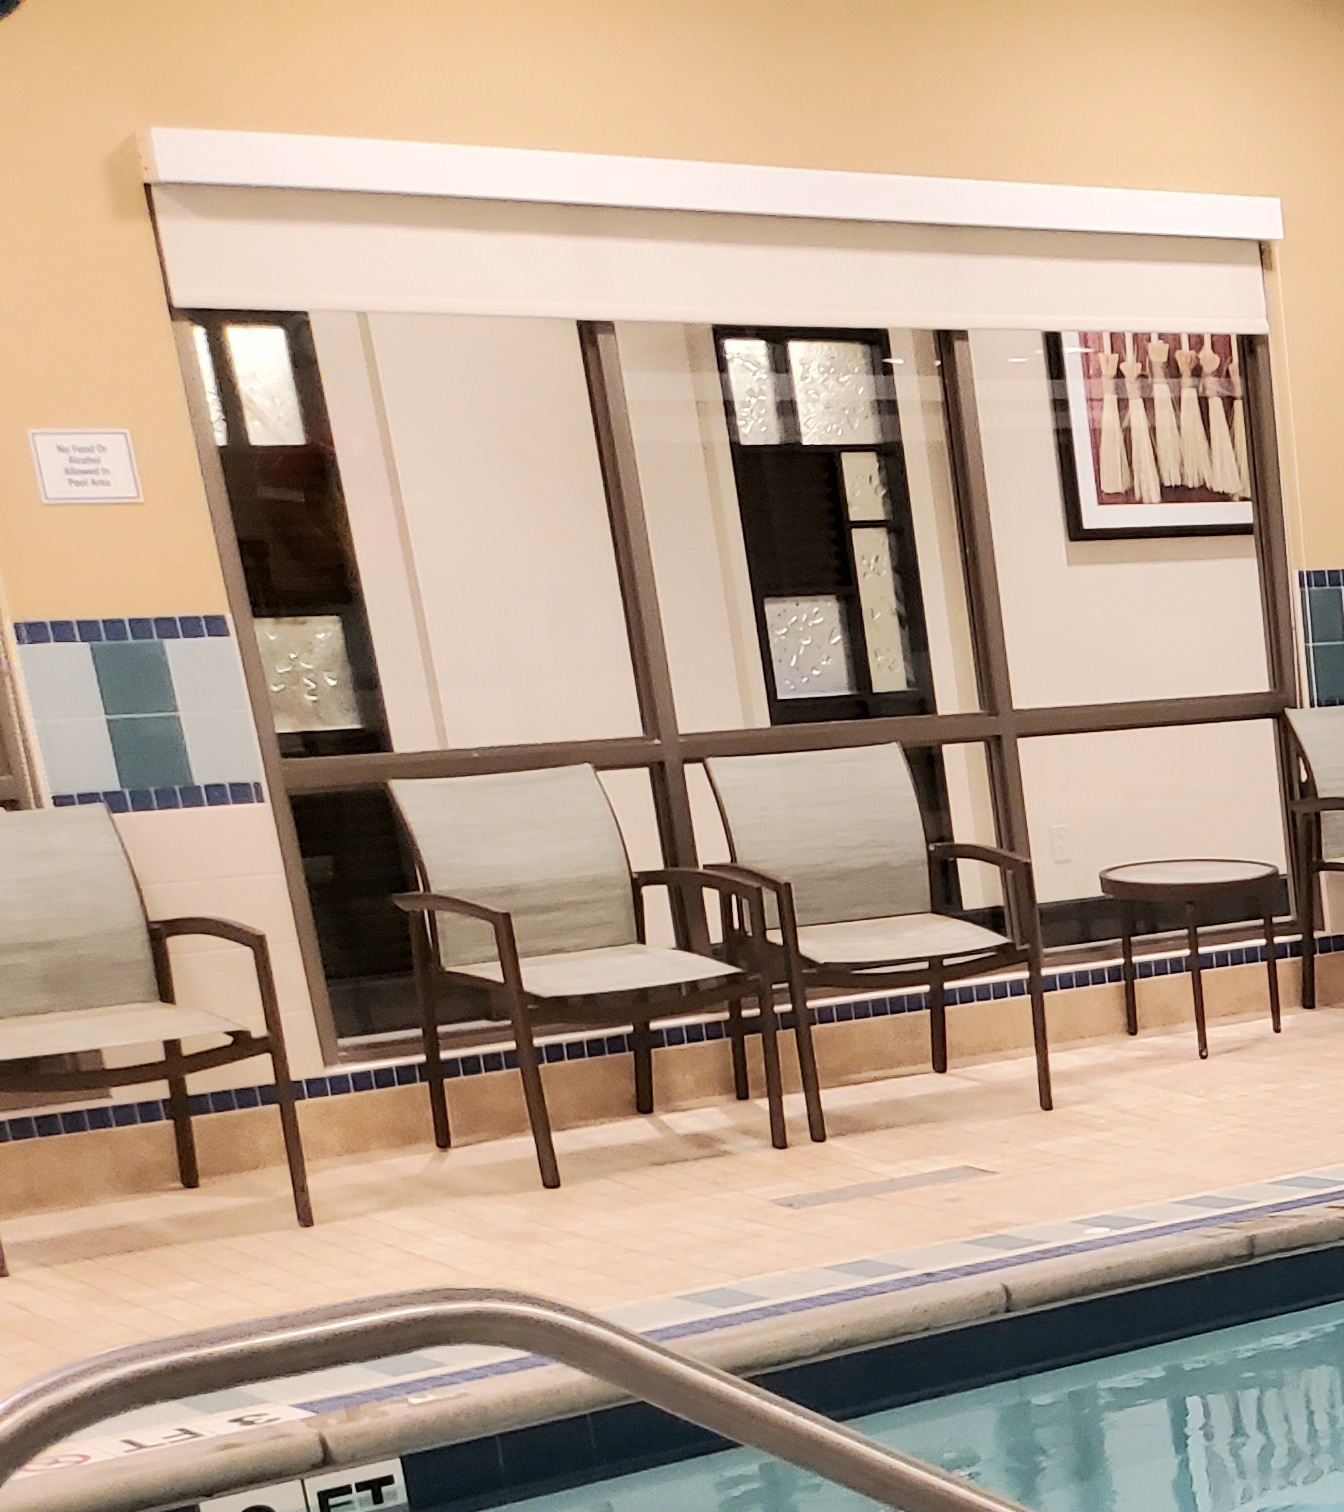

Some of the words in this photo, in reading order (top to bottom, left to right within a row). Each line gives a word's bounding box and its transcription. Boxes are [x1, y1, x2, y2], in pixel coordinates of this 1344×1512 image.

[56, 444, 70, 453] No
[67, 478, 88, 487] Pool
[120, 1428, 205, 1453] FT
